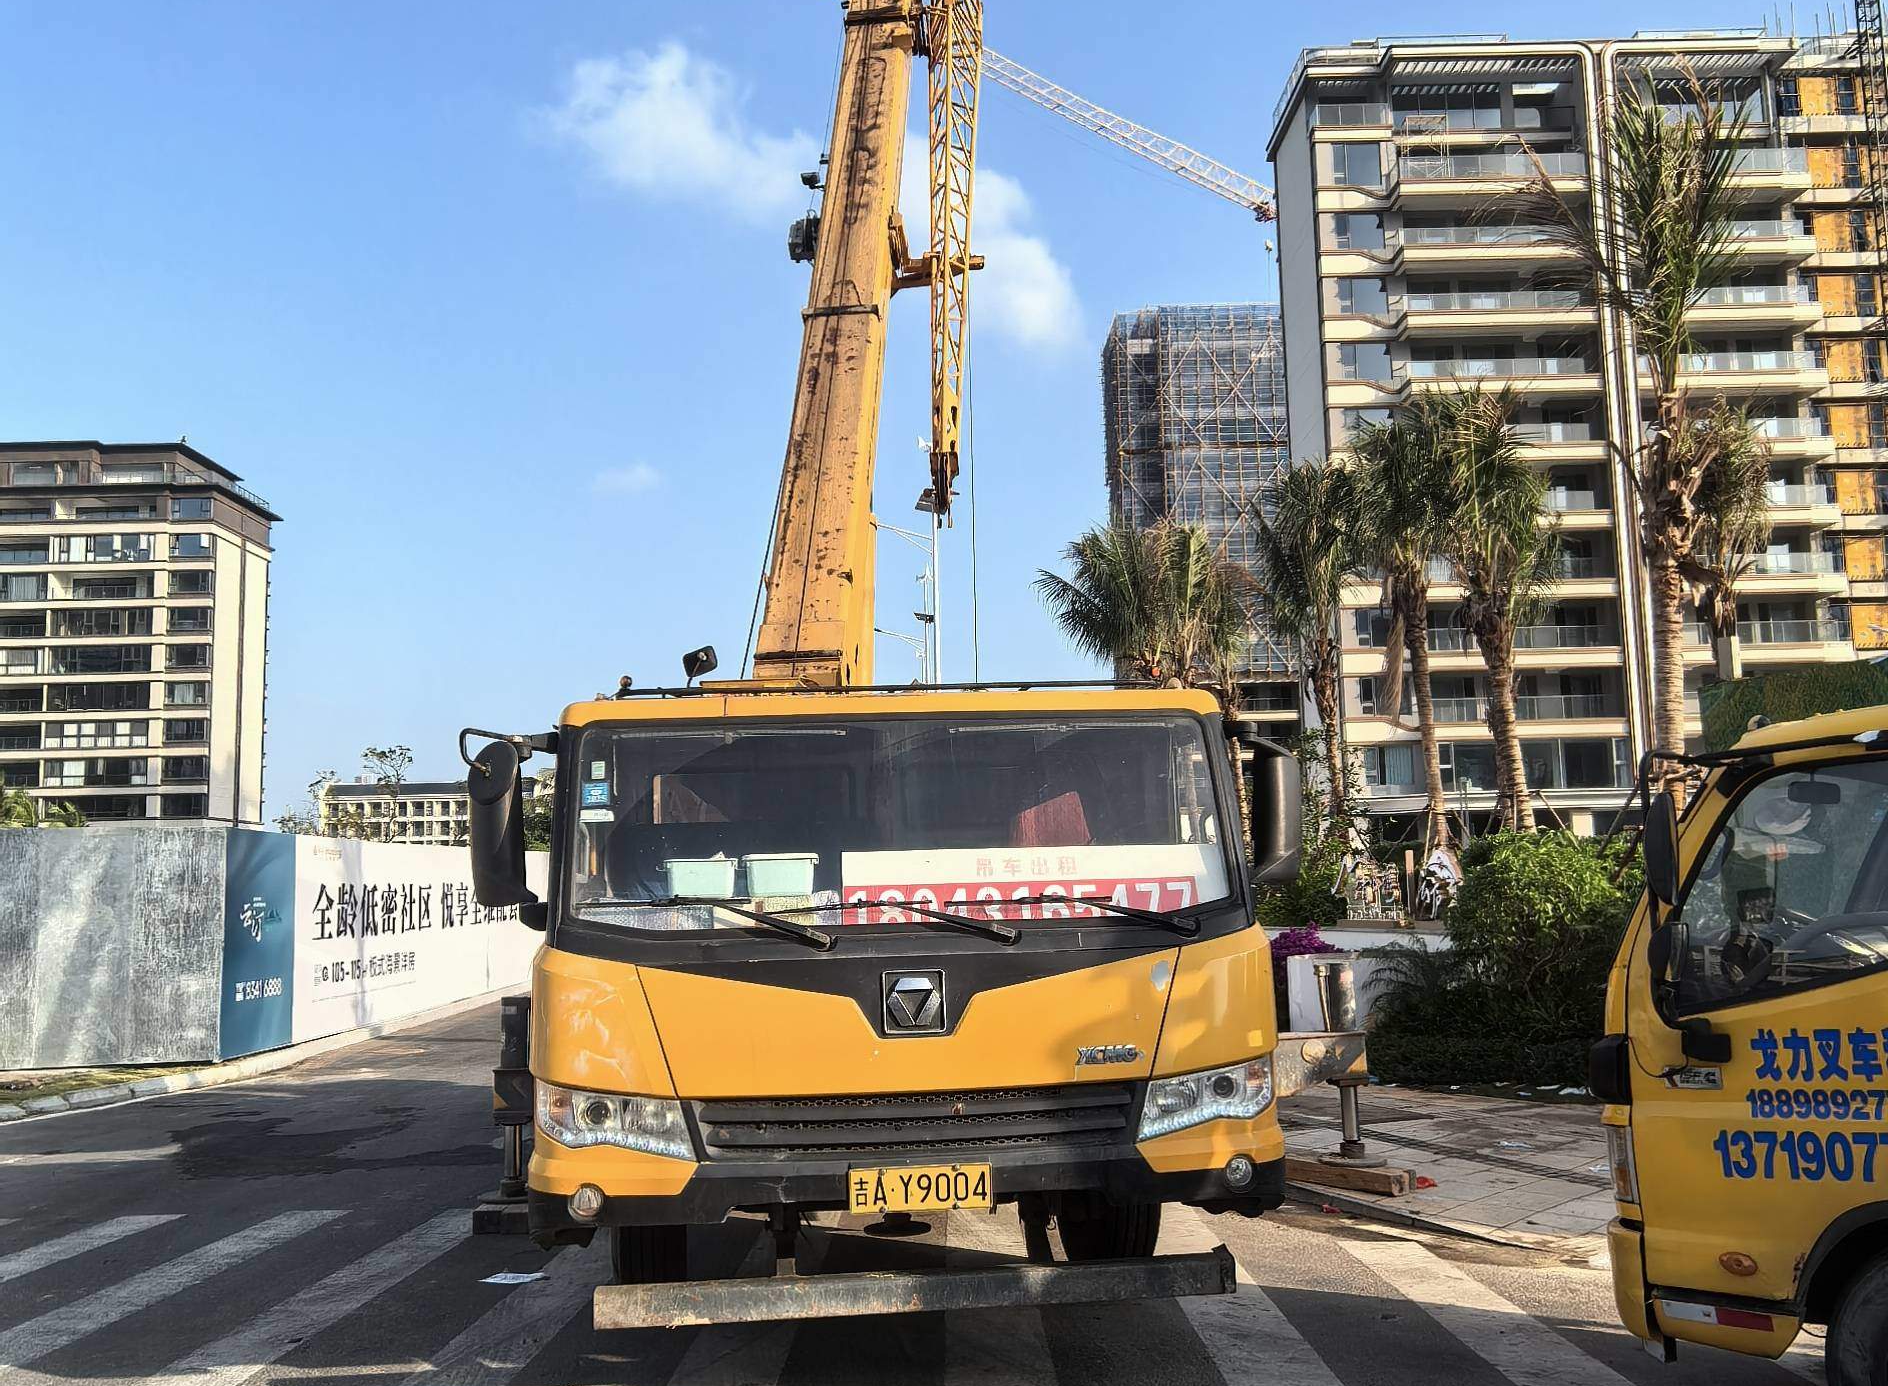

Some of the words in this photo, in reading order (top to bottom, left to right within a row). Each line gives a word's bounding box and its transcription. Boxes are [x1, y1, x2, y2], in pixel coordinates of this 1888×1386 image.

[312, 882, 432, 940] 全龄低密社区
[1747, 1088, 1888, 1121] 18898927
